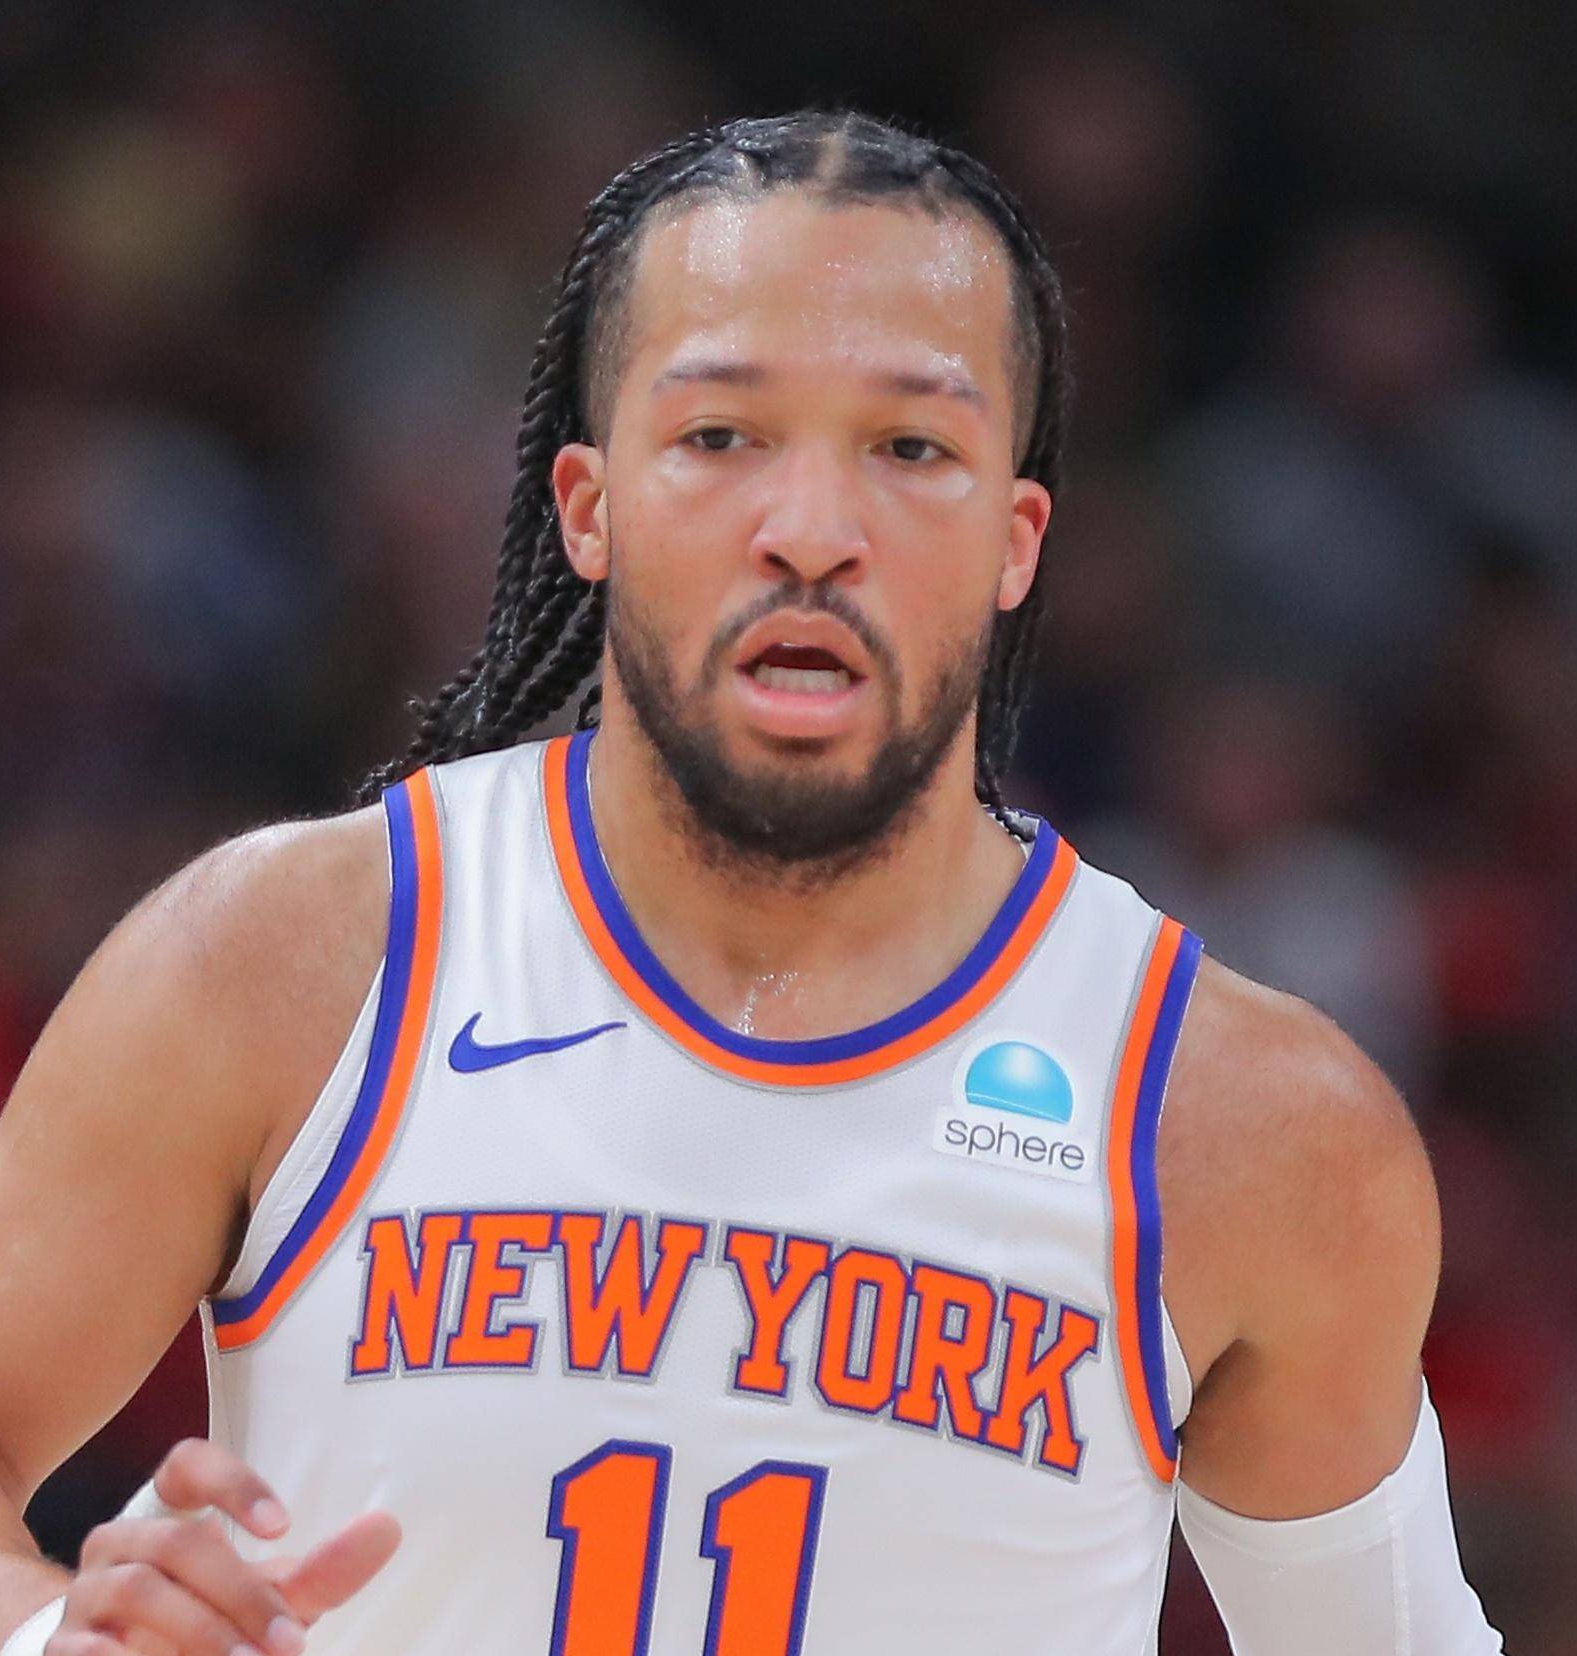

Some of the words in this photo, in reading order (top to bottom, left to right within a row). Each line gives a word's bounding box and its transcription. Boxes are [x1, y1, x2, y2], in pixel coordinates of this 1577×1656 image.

[944, 1118, 1085, 1171] sphere
[345, 1206, 709, 1384] NEW
[718, 1217, 1107, 1483] YORK
